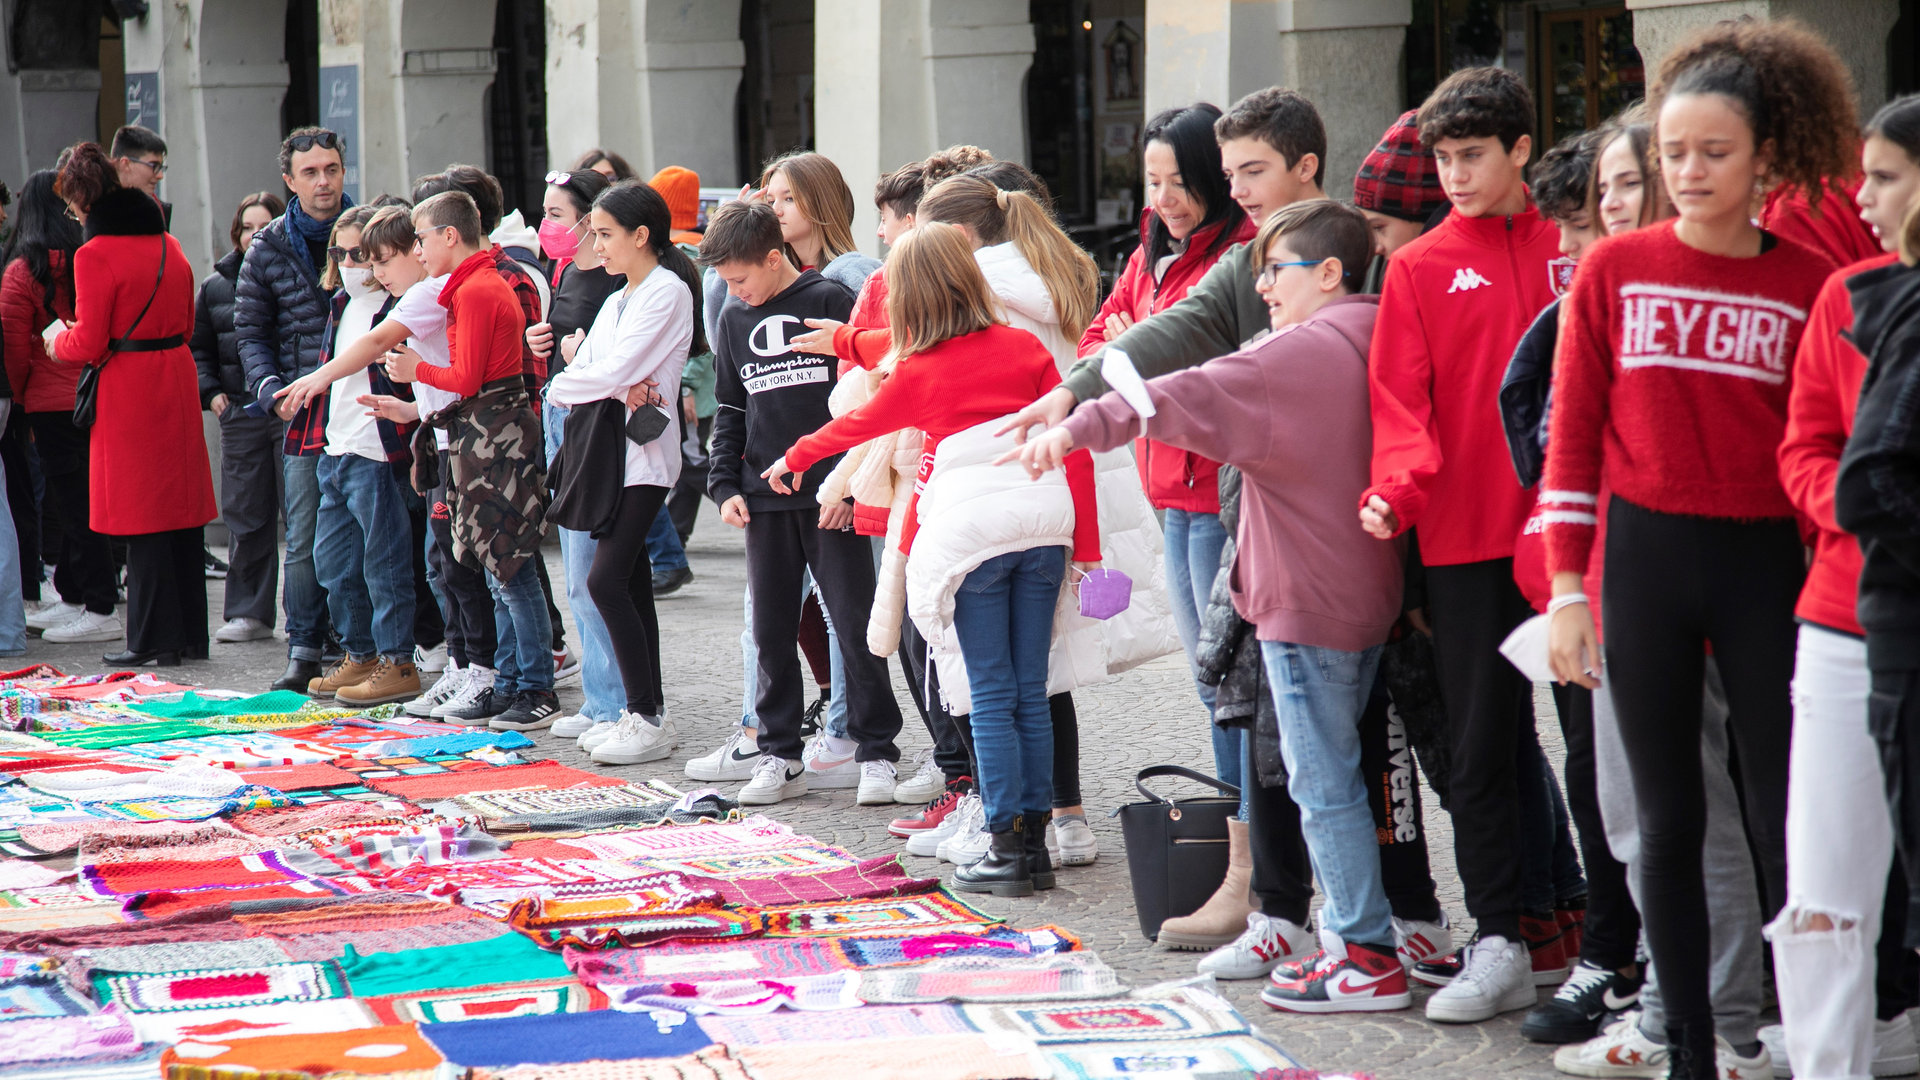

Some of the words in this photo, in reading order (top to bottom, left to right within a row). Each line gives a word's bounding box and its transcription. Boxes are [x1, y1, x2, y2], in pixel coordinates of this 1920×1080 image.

[1622, 297, 1703, 356] HEY
[740, 355, 825, 379] Champion
[749, 378, 768, 391] NEW
[769, 373, 794, 385] YORK
[796, 371, 816, 381] N.Y.
[1387, 687, 1417, 844] onverse
